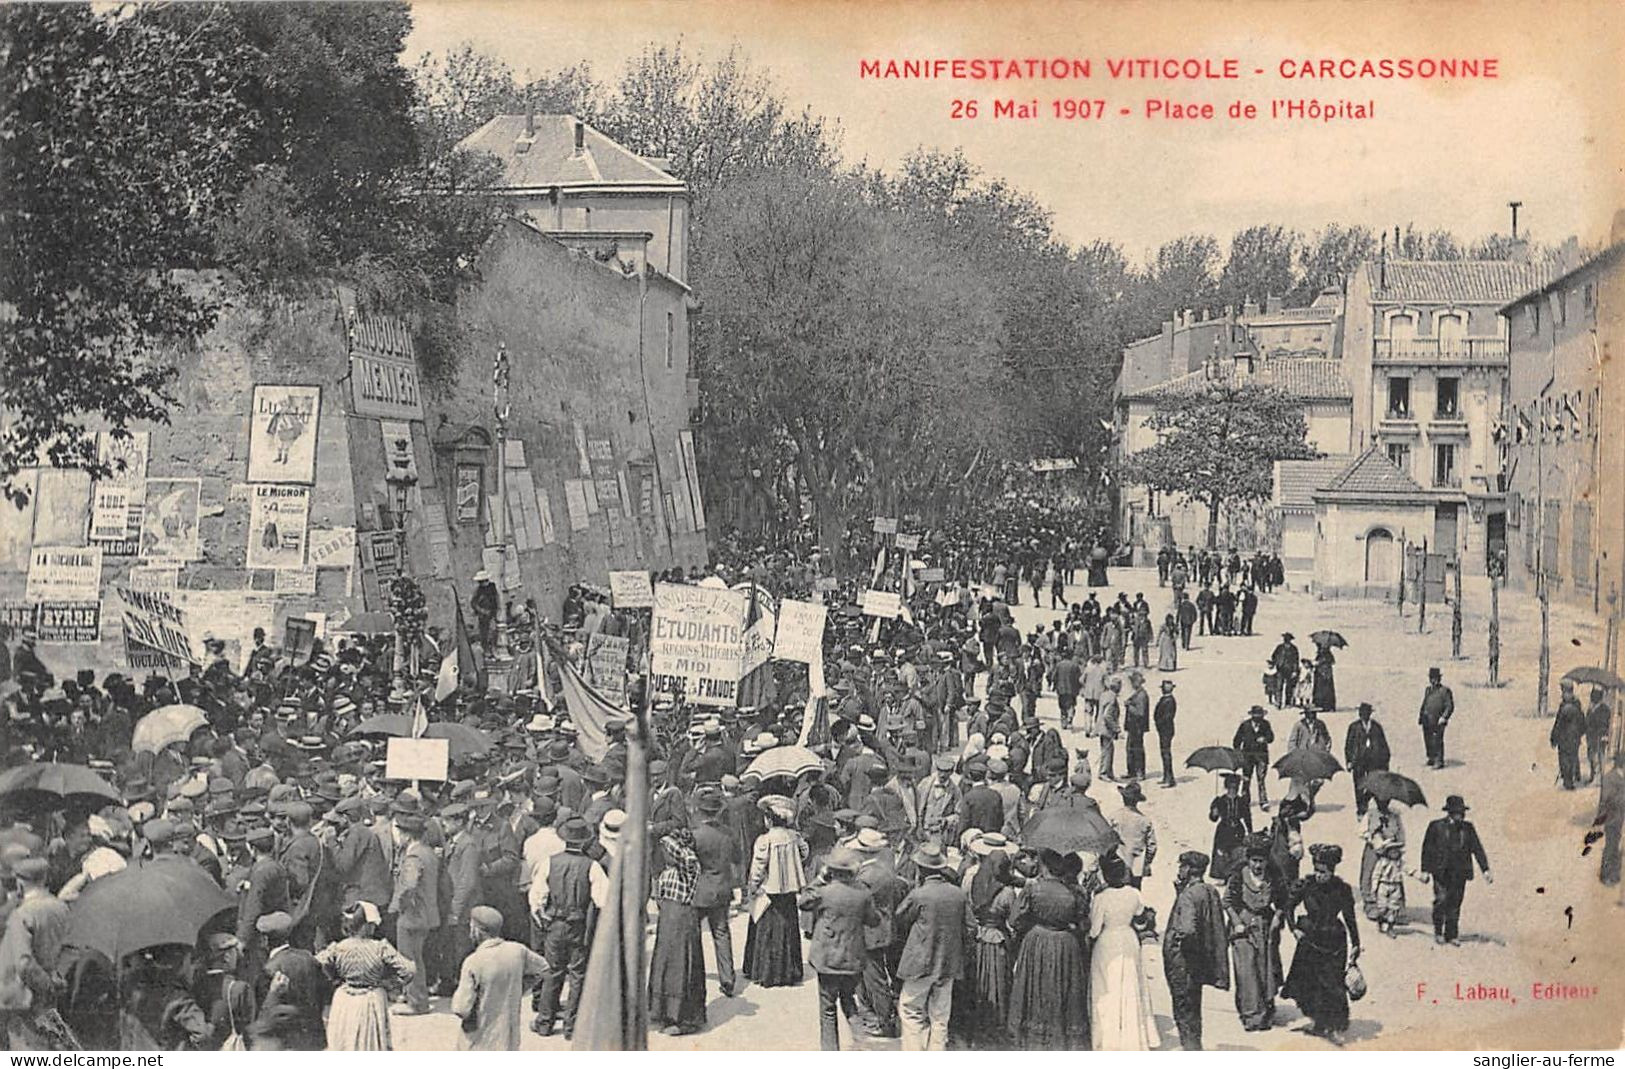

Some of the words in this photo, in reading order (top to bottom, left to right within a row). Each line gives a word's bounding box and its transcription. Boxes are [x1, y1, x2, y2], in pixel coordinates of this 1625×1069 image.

[361, 358, 417, 406] MENIER
[257, 487, 268, 497] LE
[269, 487, 306, 498] MIGNON
[43, 608, 96, 628] BYRRH
[676, 659, 711, 674] MIDI
[698, 677, 736, 699] FRAUDE
